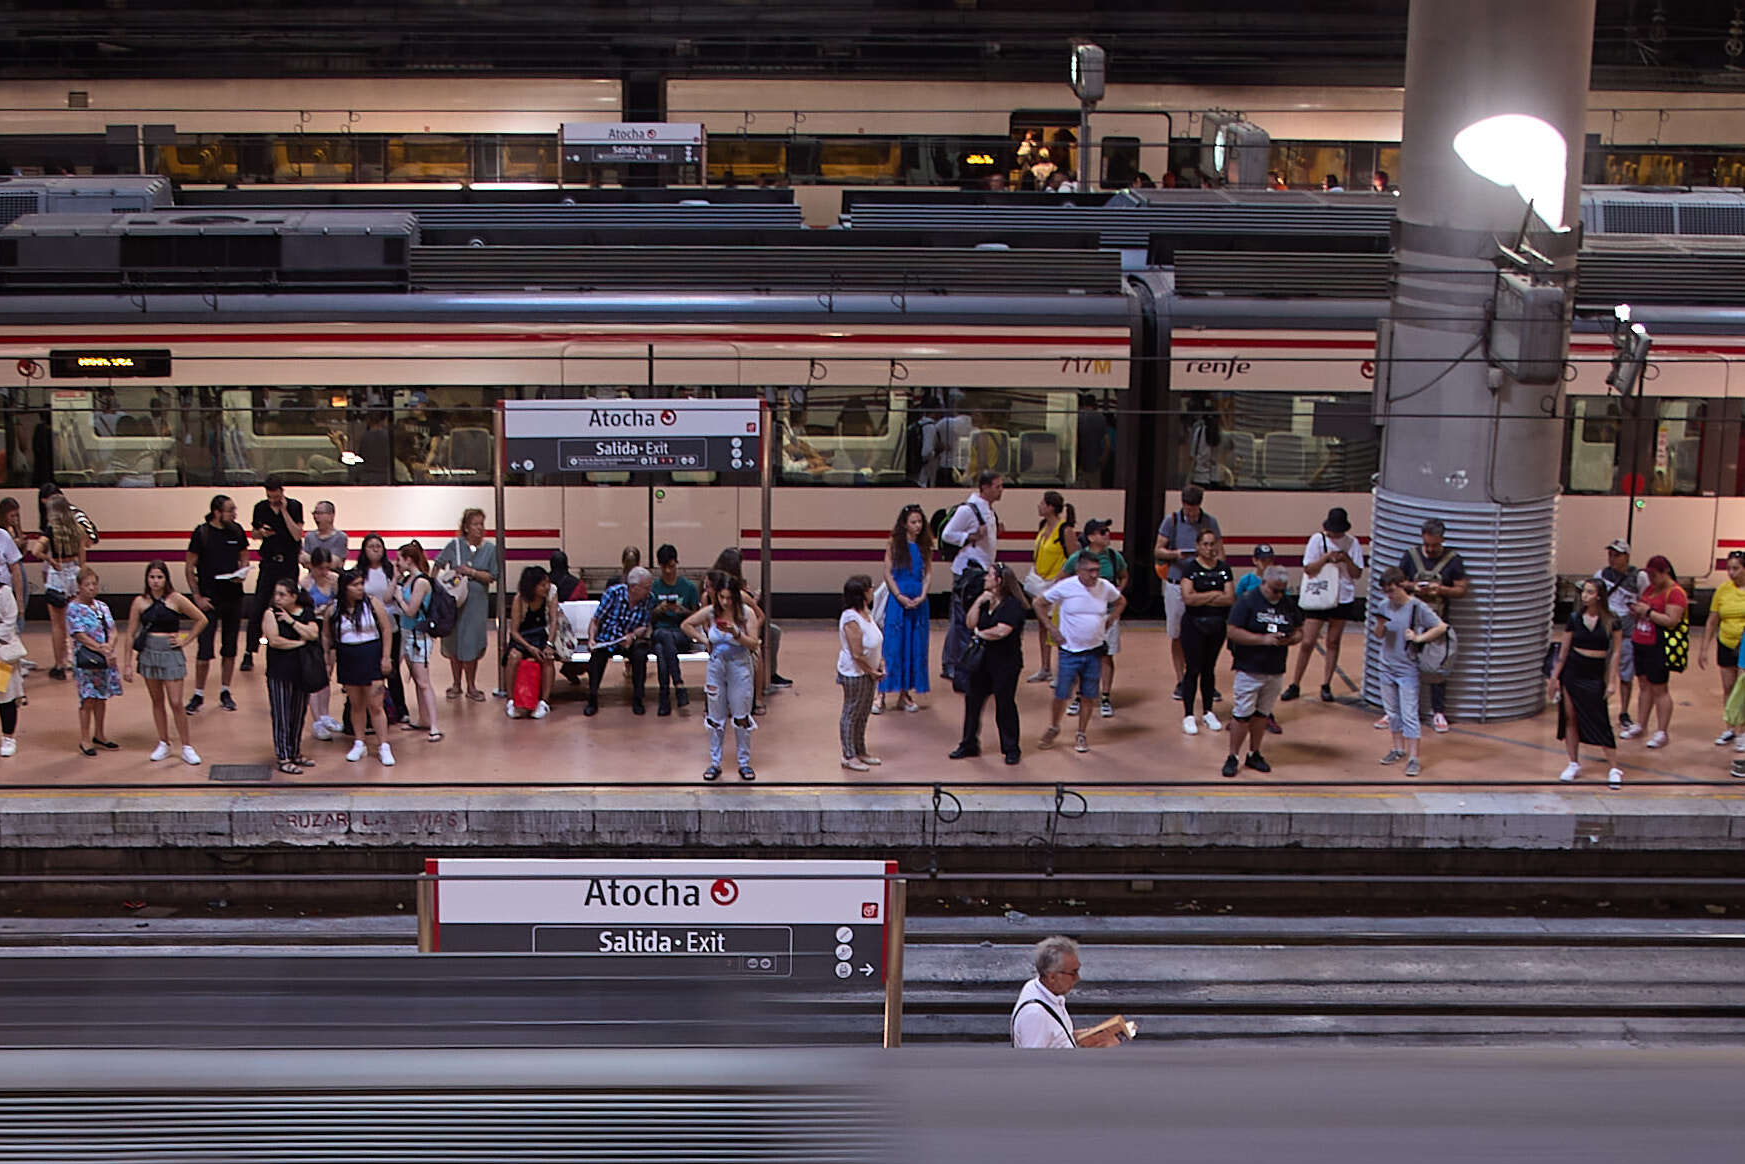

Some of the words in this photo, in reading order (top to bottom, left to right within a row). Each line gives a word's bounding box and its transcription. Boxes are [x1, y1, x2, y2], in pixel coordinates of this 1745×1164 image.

[609, 127, 645, 140] Atocha
[1060, 356, 1112, 375] 717M
[1186, 355, 1251, 381] renfe
[589, 409, 655, 427] Atocha
[596, 442, 638, 456] Salida
[645, 441, 669, 455] Exit
[272, 811, 348, 829] CRUZAR
[584, 878, 701, 907] Atocha
[598, 931, 672, 954] Salida
[686, 931, 726, 954] Exit
